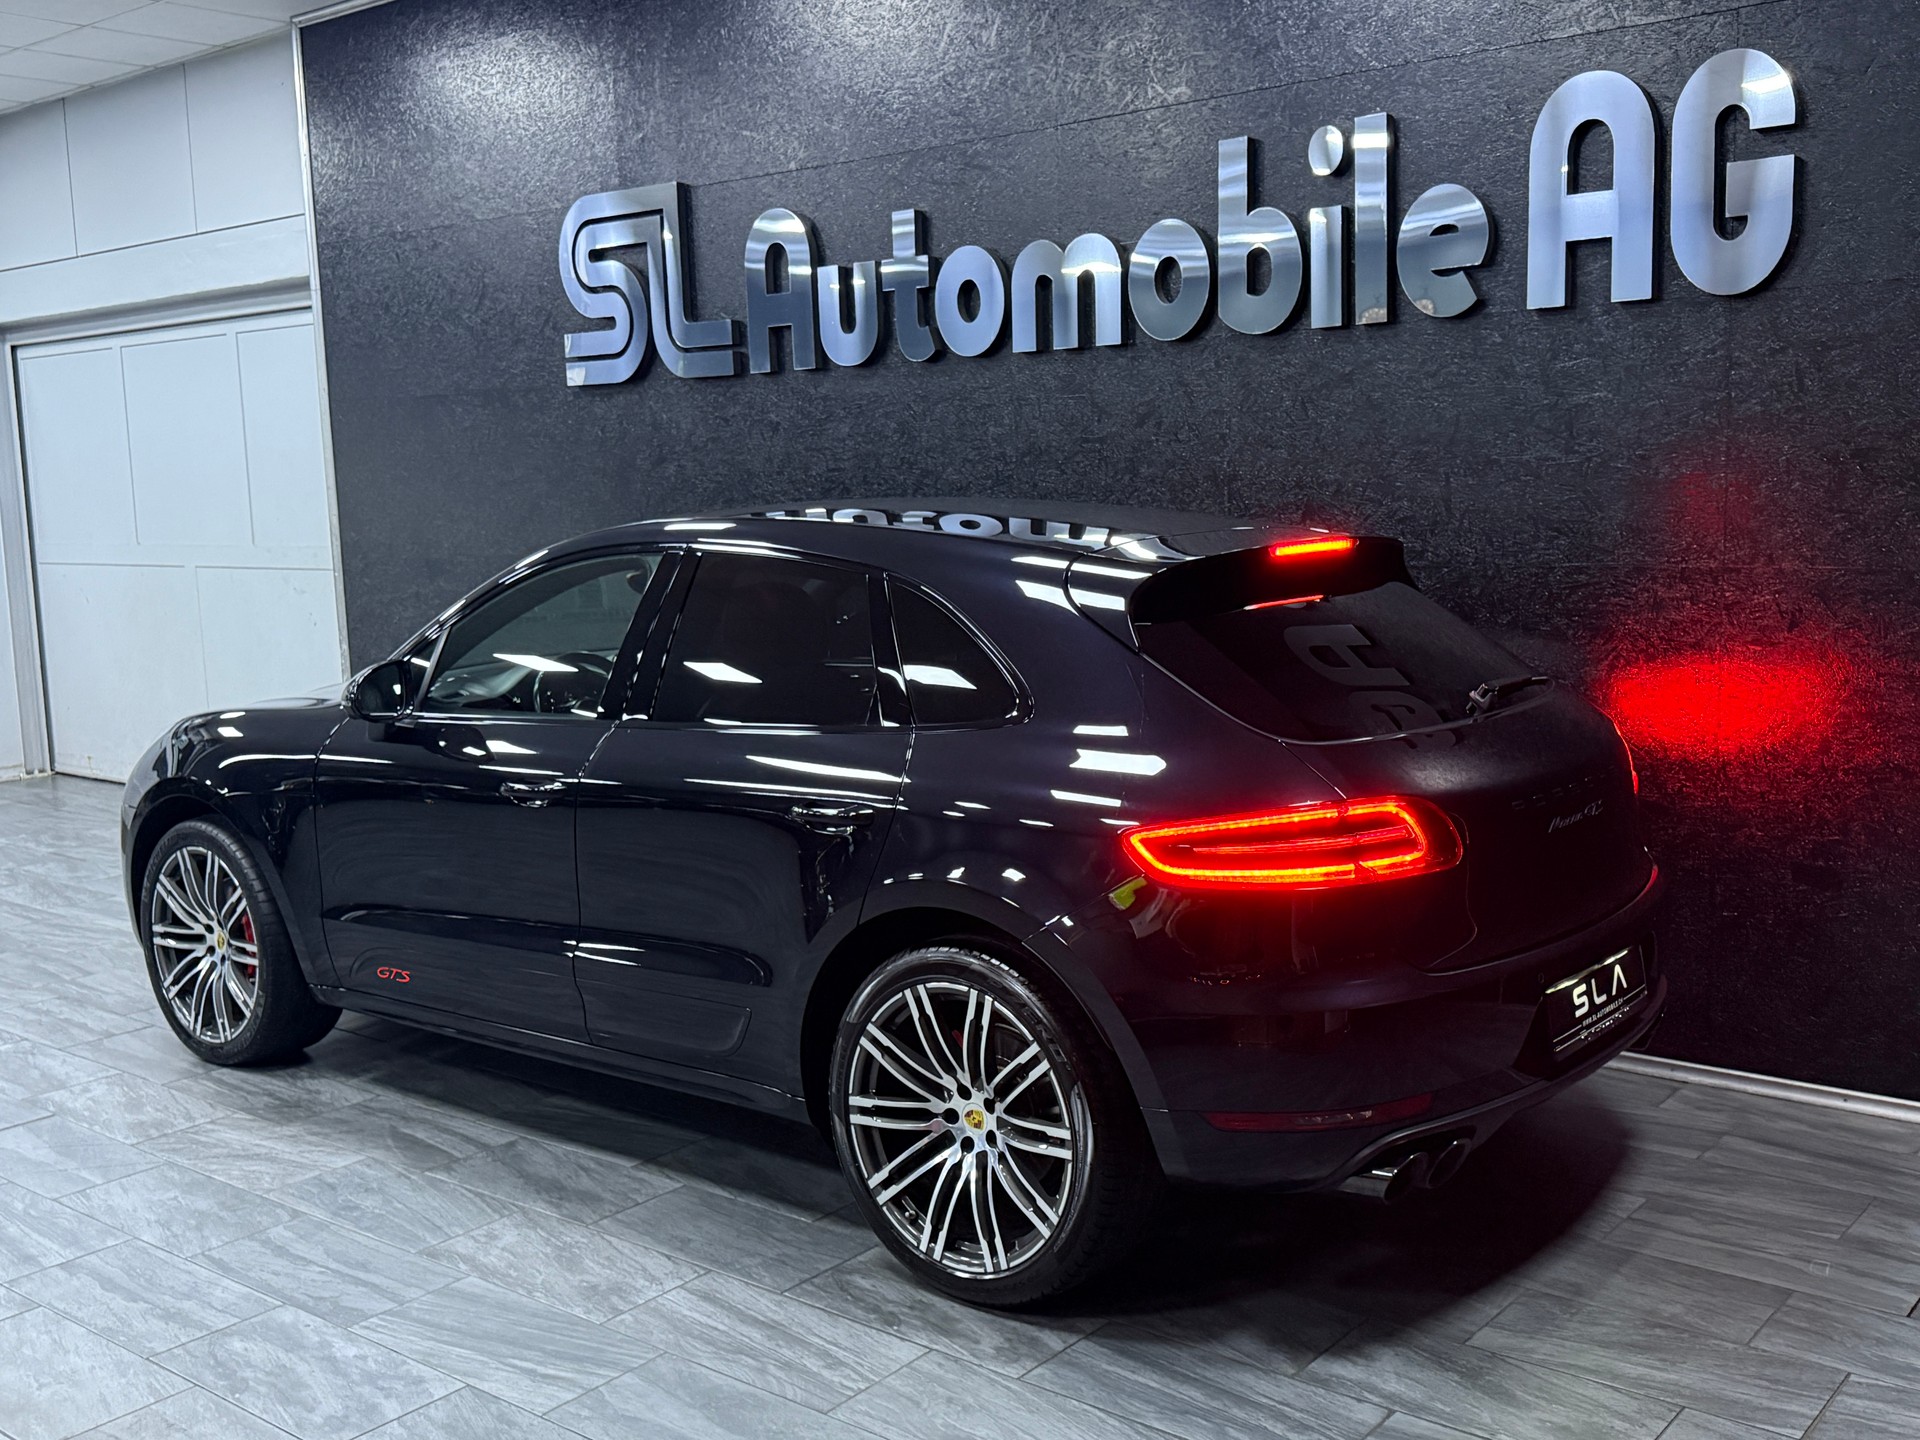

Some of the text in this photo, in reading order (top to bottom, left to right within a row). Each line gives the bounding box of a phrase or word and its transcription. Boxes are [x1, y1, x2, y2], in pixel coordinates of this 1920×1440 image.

[559, 47, 1797, 387] SL Automobile AG
[376, 966, 411, 983] GTS
